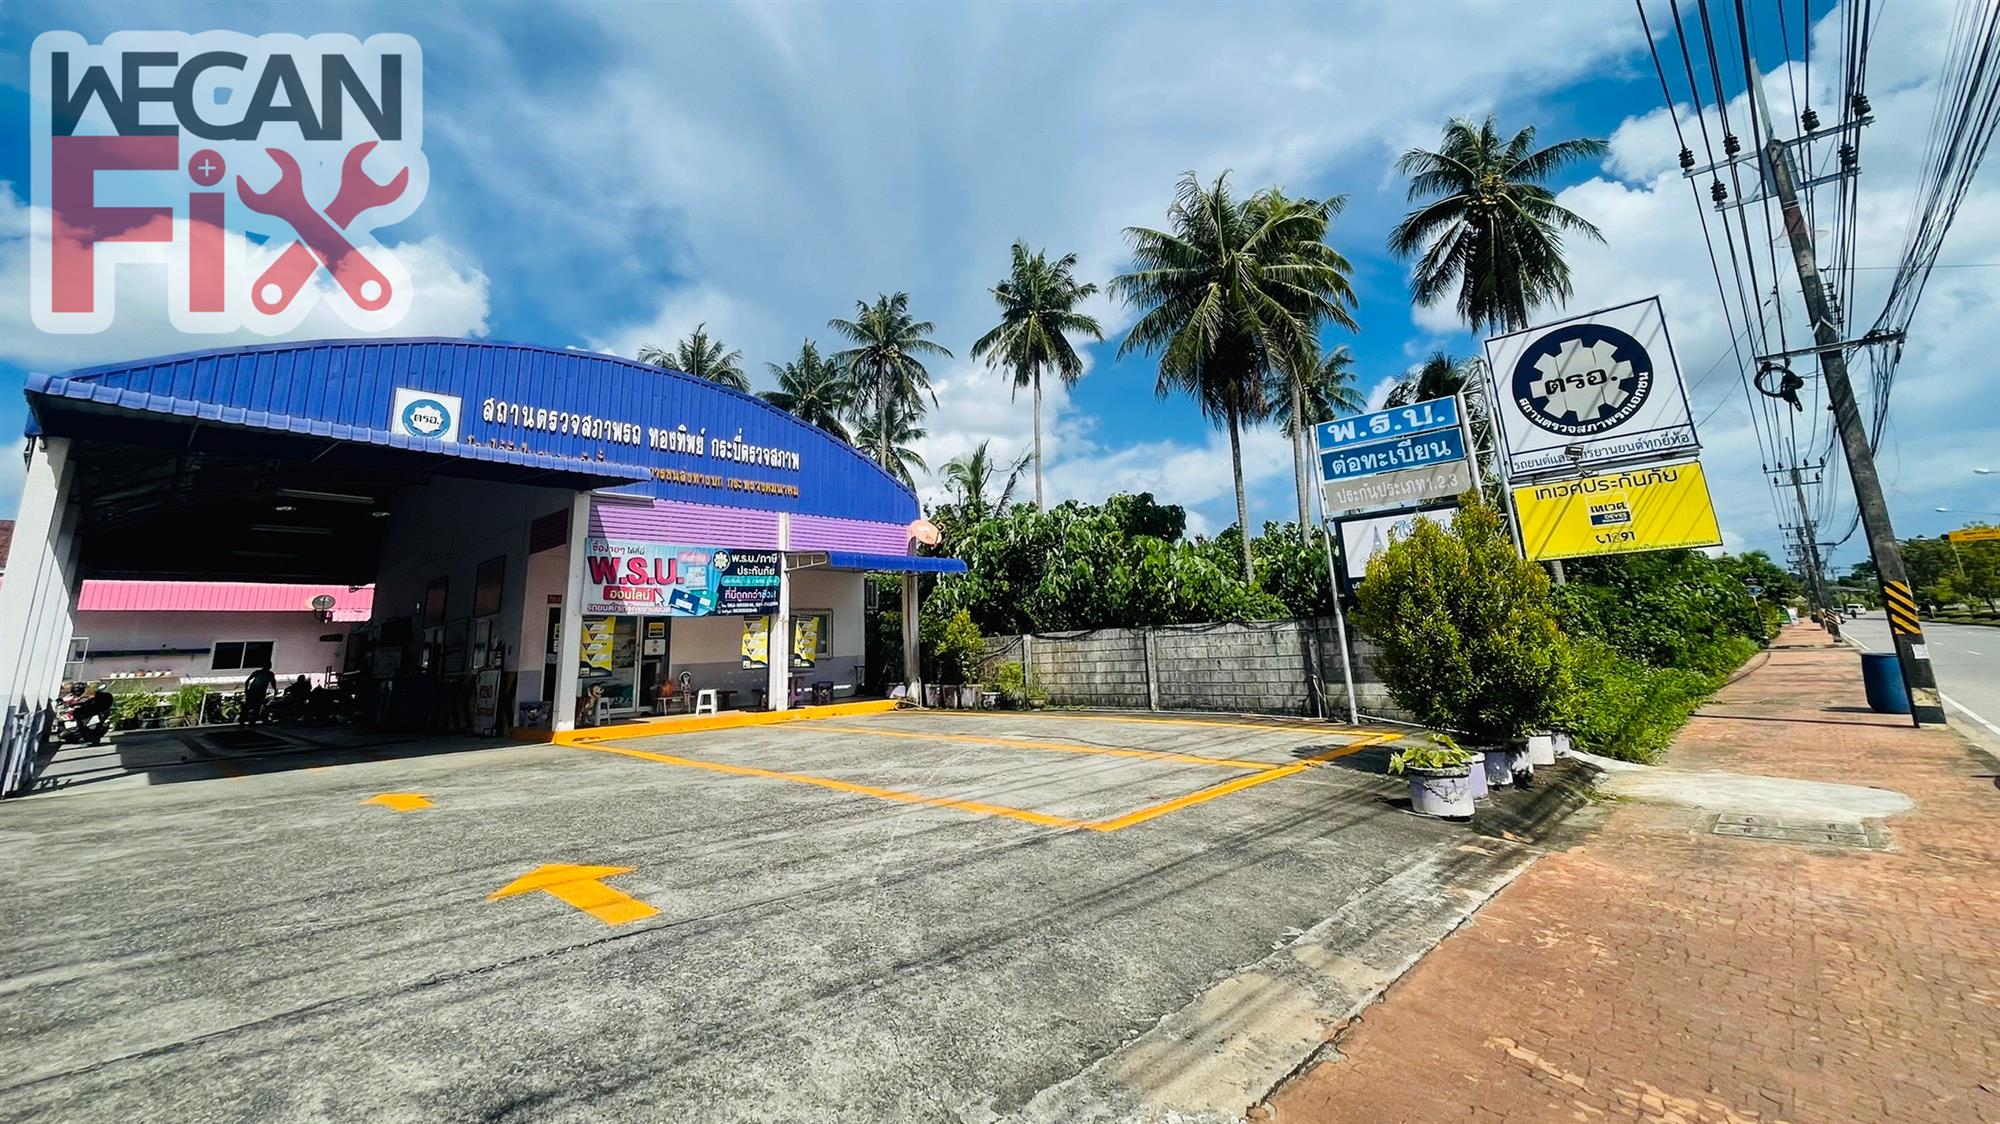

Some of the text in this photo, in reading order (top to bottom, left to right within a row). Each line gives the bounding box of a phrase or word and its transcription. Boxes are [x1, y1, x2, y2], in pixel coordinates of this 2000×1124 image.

[1544, 368, 1618, 395] ตรอ.
[1519, 371, 1650, 435] สถานตรวจสภาพรถเอกชน
[413, 414, 440, 425] ตรอ.
[482, 397, 641, 447] สถานตรวจสภาพรถ
[648, 424, 706, 456] ทองทิพย์
[711, 428, 800, 471] กระบี่ตรวจสภาพ
[1327, 404, 1446, 443] พ.ร.บ.
[1332, 438, 1452, 475] ต่อทะเบียน
[1535, 468, 1678, 501] เทเวศประกันภัย
[1605, 531, 1635, 543] 1291
[737, 565, 775, 576] ประกันภัย
[609, 587, 651, 601] ออนไลน์
